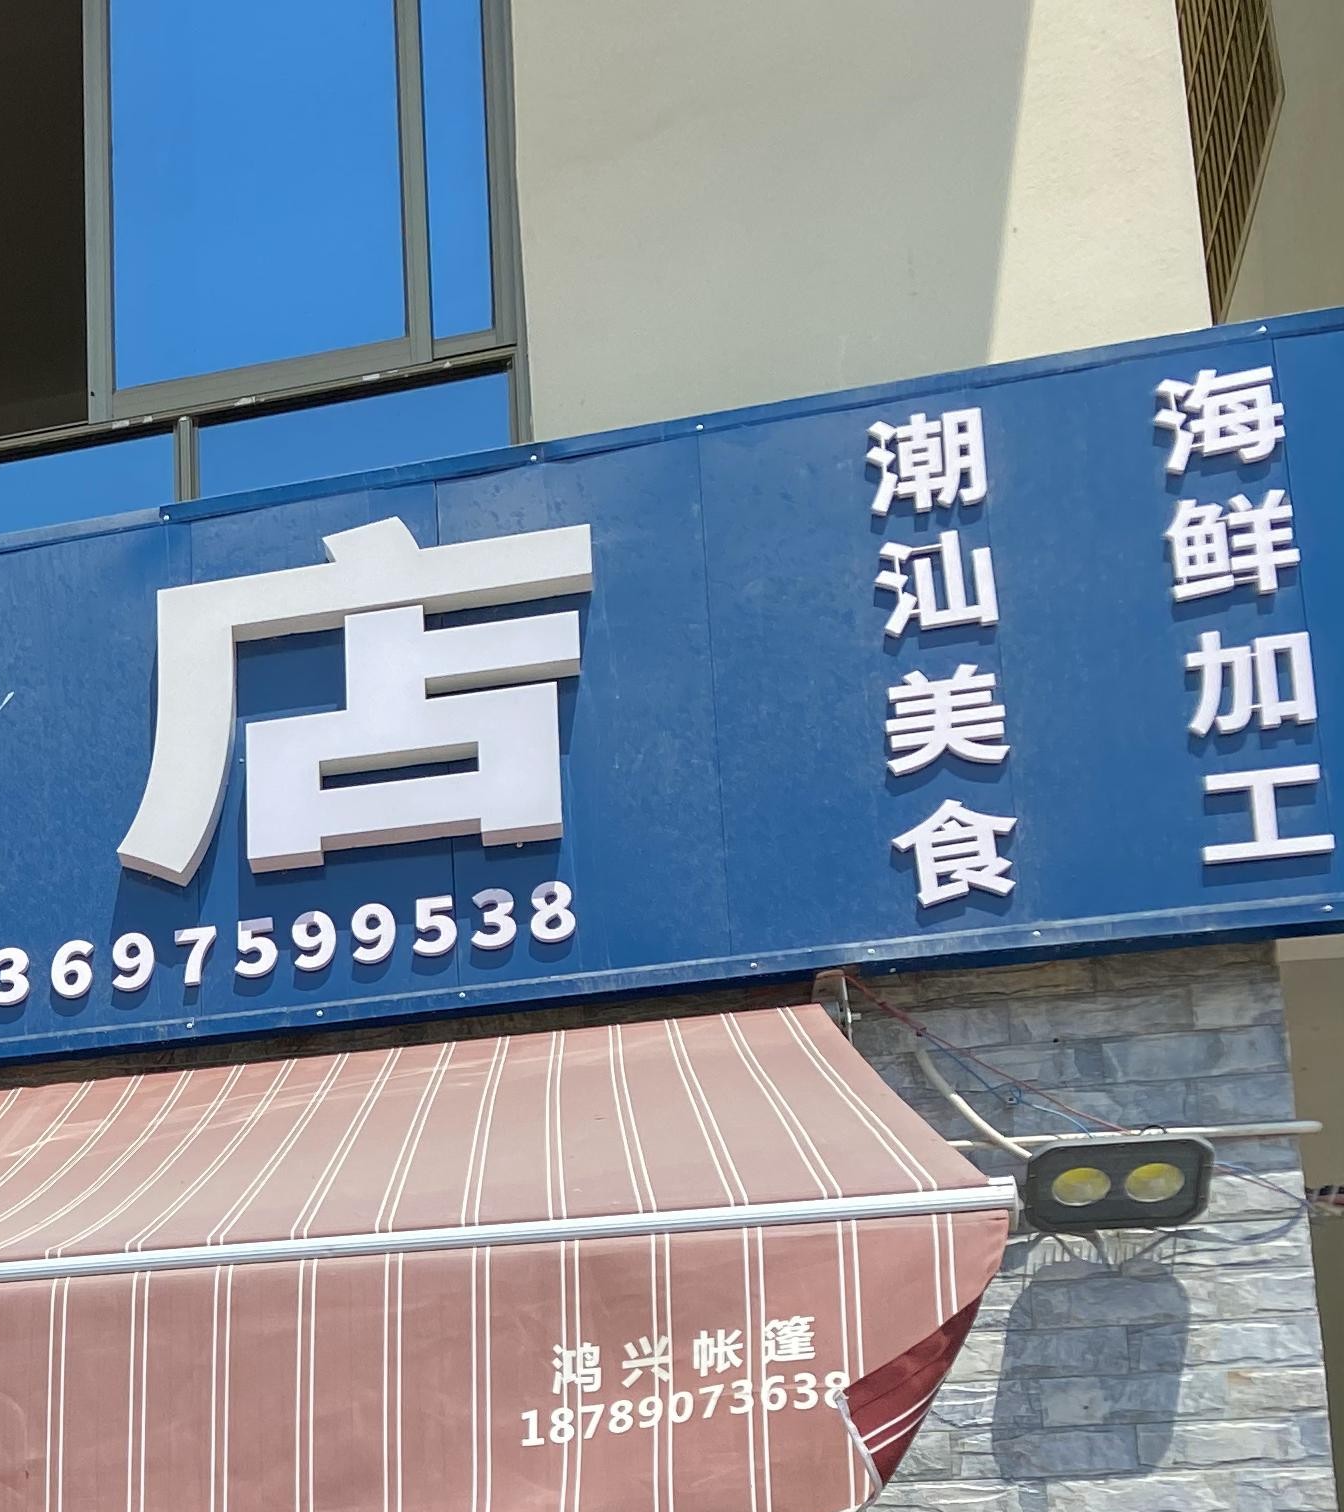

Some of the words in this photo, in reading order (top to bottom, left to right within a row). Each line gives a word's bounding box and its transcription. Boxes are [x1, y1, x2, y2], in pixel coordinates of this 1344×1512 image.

[866, 407, 1017, 908] 潮汕美食
[1153, 366, 1335, 865] 海鲜加工
[519, 1371, 851, 1448] 18789073638
